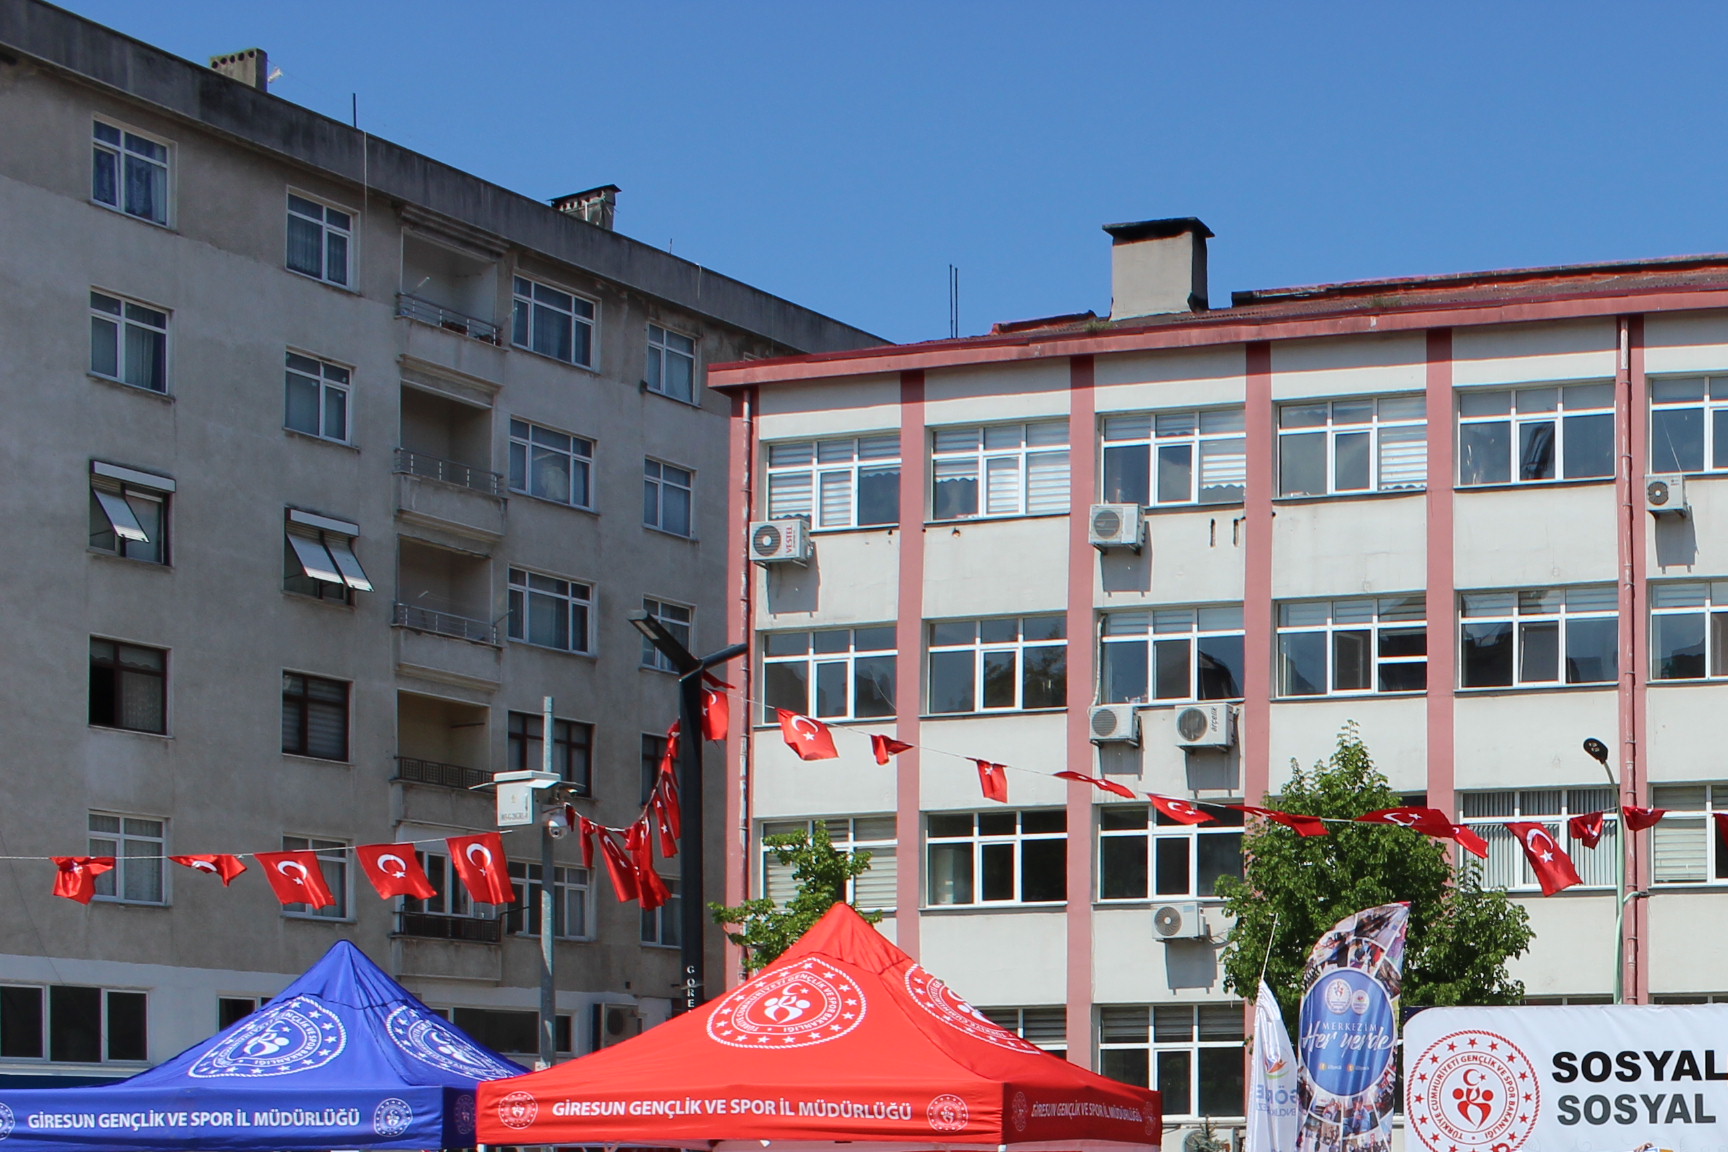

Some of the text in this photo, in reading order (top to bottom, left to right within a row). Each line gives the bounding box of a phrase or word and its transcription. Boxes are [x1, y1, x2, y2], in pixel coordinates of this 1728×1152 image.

[785, 525, 793, 554] VESTEL
[1301, 1020, 1394, 1058] Her yerde
[1552, 1050, 1728, 1083] SOSYAL
[552, 1097, 912, 1121] GİRESUN GENÇLİK VE SPOR İL MÜDÜRLÜĞÜ
[1430, 1054, 1516, 1140] TÜRKİYE CUMHURİYETİ GENÇLİK VE SPOR BAKANLIĞI
[1557, 1093, 1716, 1126] SOSYAL
[27, 1108, 361, 1131] GİRESUN GENÇLİK VE SPOR İL MÜDÜRLÜĞÜ
